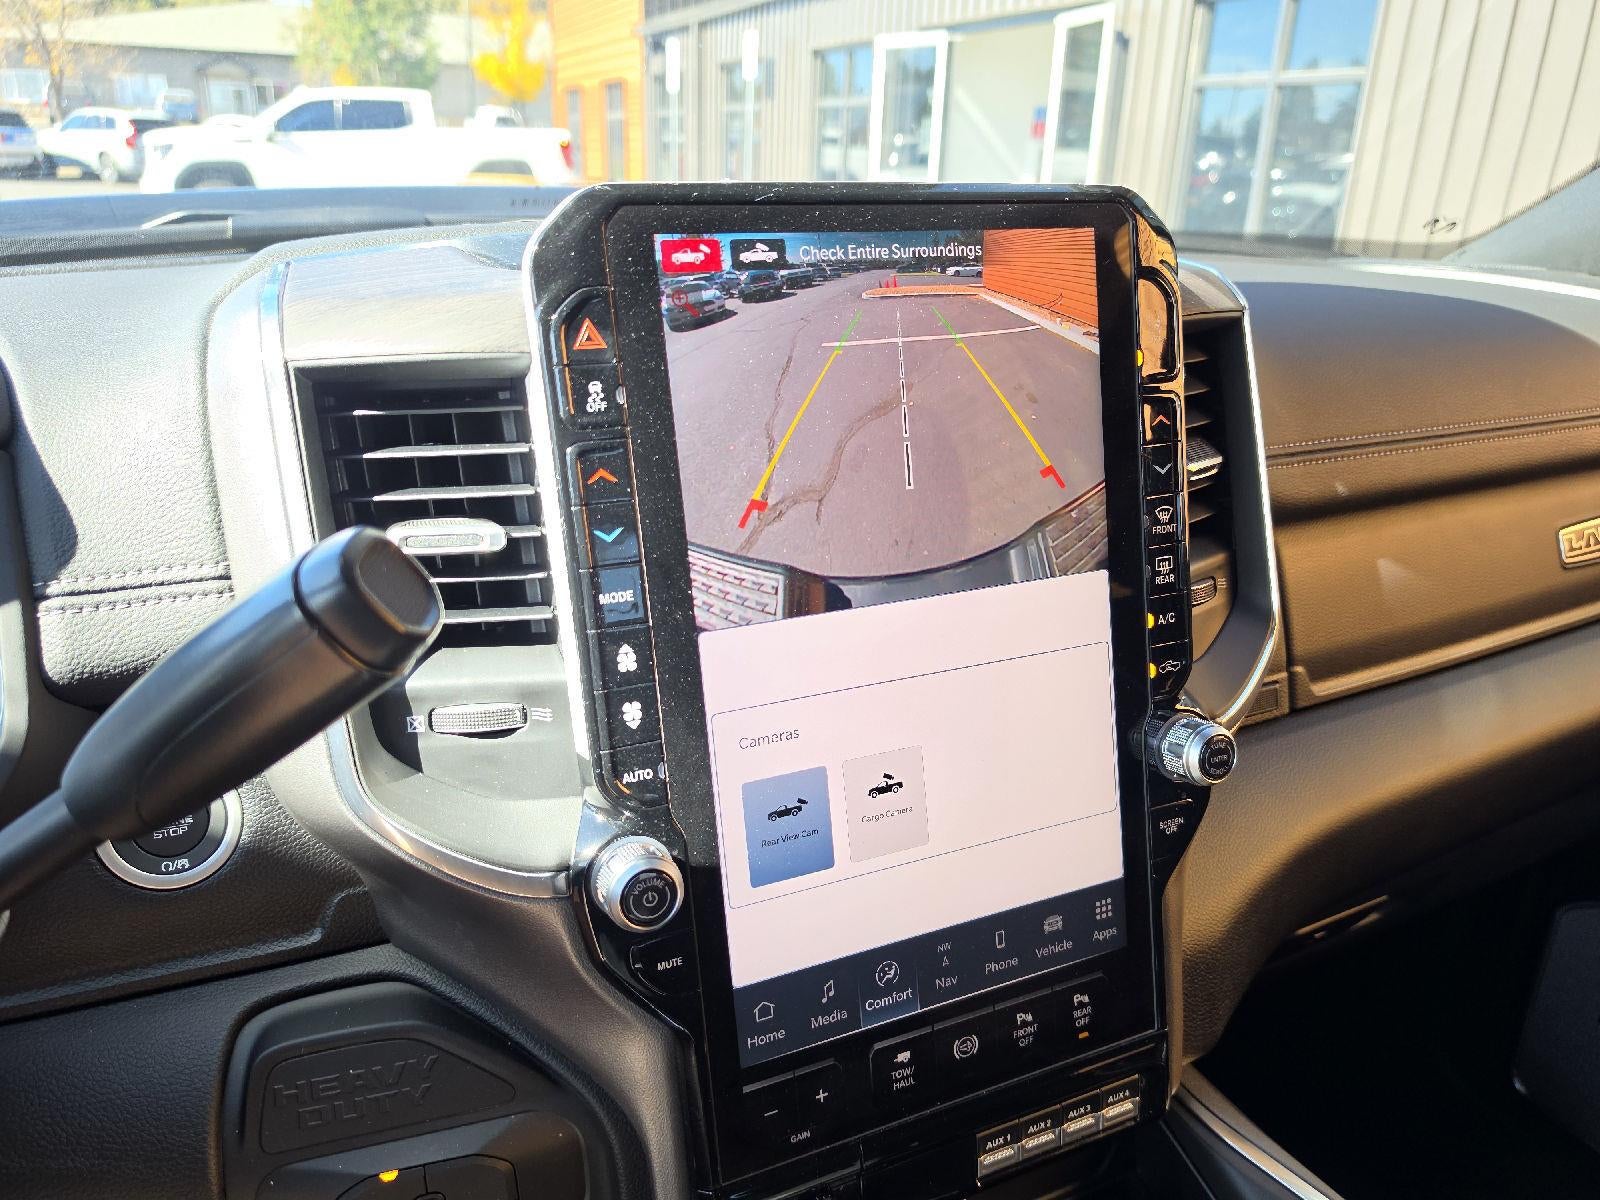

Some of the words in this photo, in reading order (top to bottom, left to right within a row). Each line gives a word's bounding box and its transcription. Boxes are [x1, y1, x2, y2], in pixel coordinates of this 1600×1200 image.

[800, 244, 845, 261] Check
[848, 243, 889, 260] Entire
[891, 243, 982, 260] Surroundings
[586, 401, 608, 413] OFF
[1152, 523, 1177, 535] FRONT
[1155, 573, 1175, 585] REAR
[598, 589, 635, 605] MODE
[1158, 612, 1176, 625] A/C
[739, 728, 800, 750] Cameras
[622, 768, 654, 784] AUTO
[861, 811, 884, 824] Cargo
[885, 806, 913, 818] Camera
[1160, 817, 1184, 830] SCREEN
[1165, 825, 1178, 834] OFF
[153, 825, 188, 839] STOP
[761, 837, 780, 848] Rear
[780, 831, 801, 843] View
[801, 828, 819, 839] Cam
[631, 877, 665, 896] VOLUME
[1092, 927, 1117, 942] Apps
[937, 942, 952, 953] NW
[1036, 939, 1073, 958] Vehicle
[657, 956, 683, 971] MUTE
[985, 957, 1019, 975] Phone
[935, 975, 958, 989] Nav
[866, 987, 913, 1011] Comfort
[810, 1009, 848, 1029] Media
[1073, 1006, 1092, 1019] REAR
[1075, 1016, 1090, 1028] OFF
[747, 1028, 786, 1048] Home
[1013, 1023, 1038, 1039] FRONT
[1018, 1035, 1034, 1047] OFF
[272, 1054, 439, 1108] HEAVY
[893, 1077, 915, 1090] HAUL
[1107, 1091, 1125, 1103] AUX
[297, 1082, 432, 1130] DUTY
[1068, 1106, 1086, 1119] AUX
[1028, 1121, 1045, 1134] AUX
[790, 1129, 811, 1143] GAIN
[986, 1137, 1005, 1150] AUX
